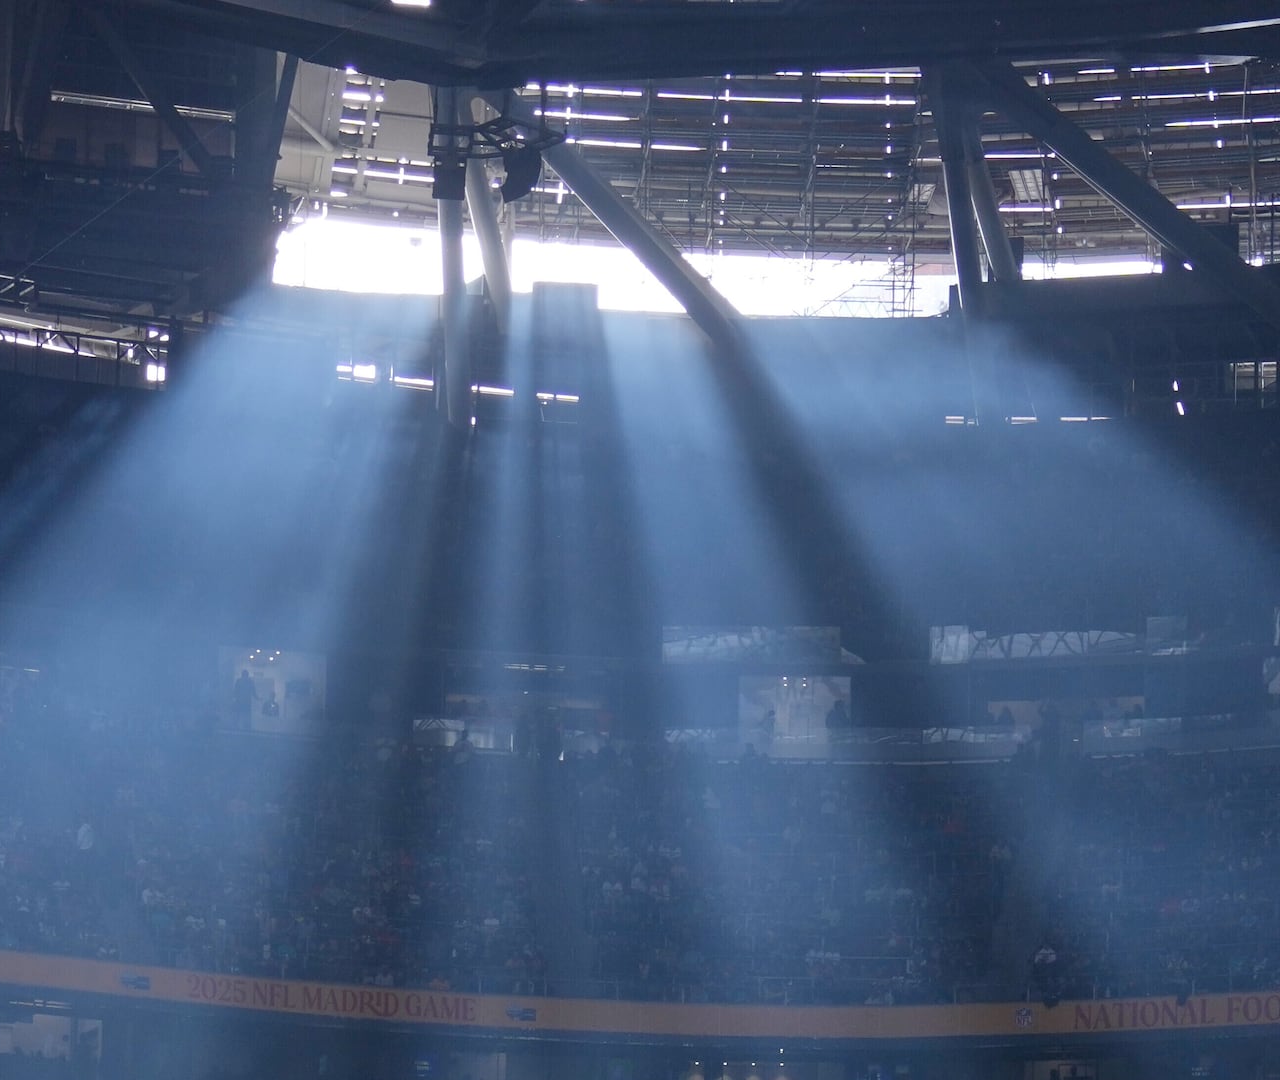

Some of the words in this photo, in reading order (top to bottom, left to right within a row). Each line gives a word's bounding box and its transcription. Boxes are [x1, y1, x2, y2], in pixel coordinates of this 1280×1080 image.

[187, 974, 247, 1004] 2025
[250, 980, 294, 1009] NFL
[302, 986, 400, 1018] MADRID
[405, 996, 476, 1022] GAME
[1073, 999, 1215, 1031] NATIONAL
